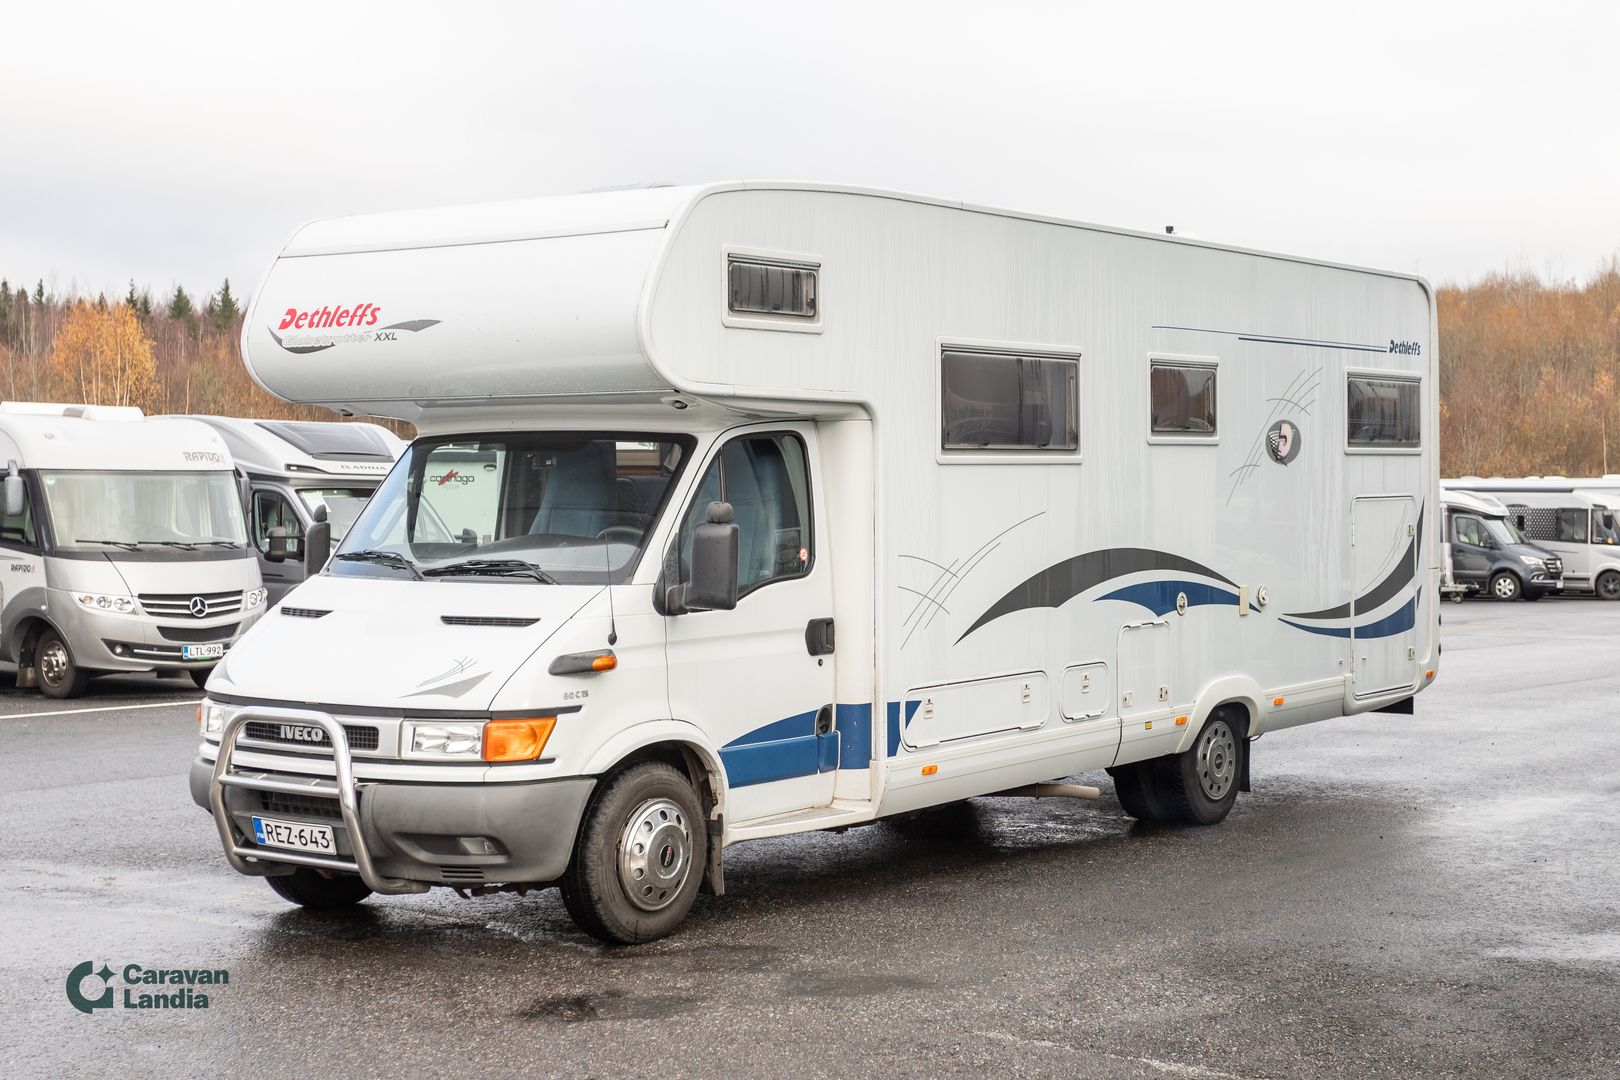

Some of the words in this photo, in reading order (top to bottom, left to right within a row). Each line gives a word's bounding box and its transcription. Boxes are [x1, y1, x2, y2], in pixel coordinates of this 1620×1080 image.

[278, 303, 381, 330] Dethleffs
[374, 332, 398, 341] XXL
[1389, 339, 1421, 356] Dethleffs
[182, 451, 220, 463] RAPIDO
[10, 564, 31, 573] RAPIDO
[189, 645, 222, 656] LTL-992
[280, 725, 323, 742] IVECO
[264, 823, 330, 849] REZ-643
